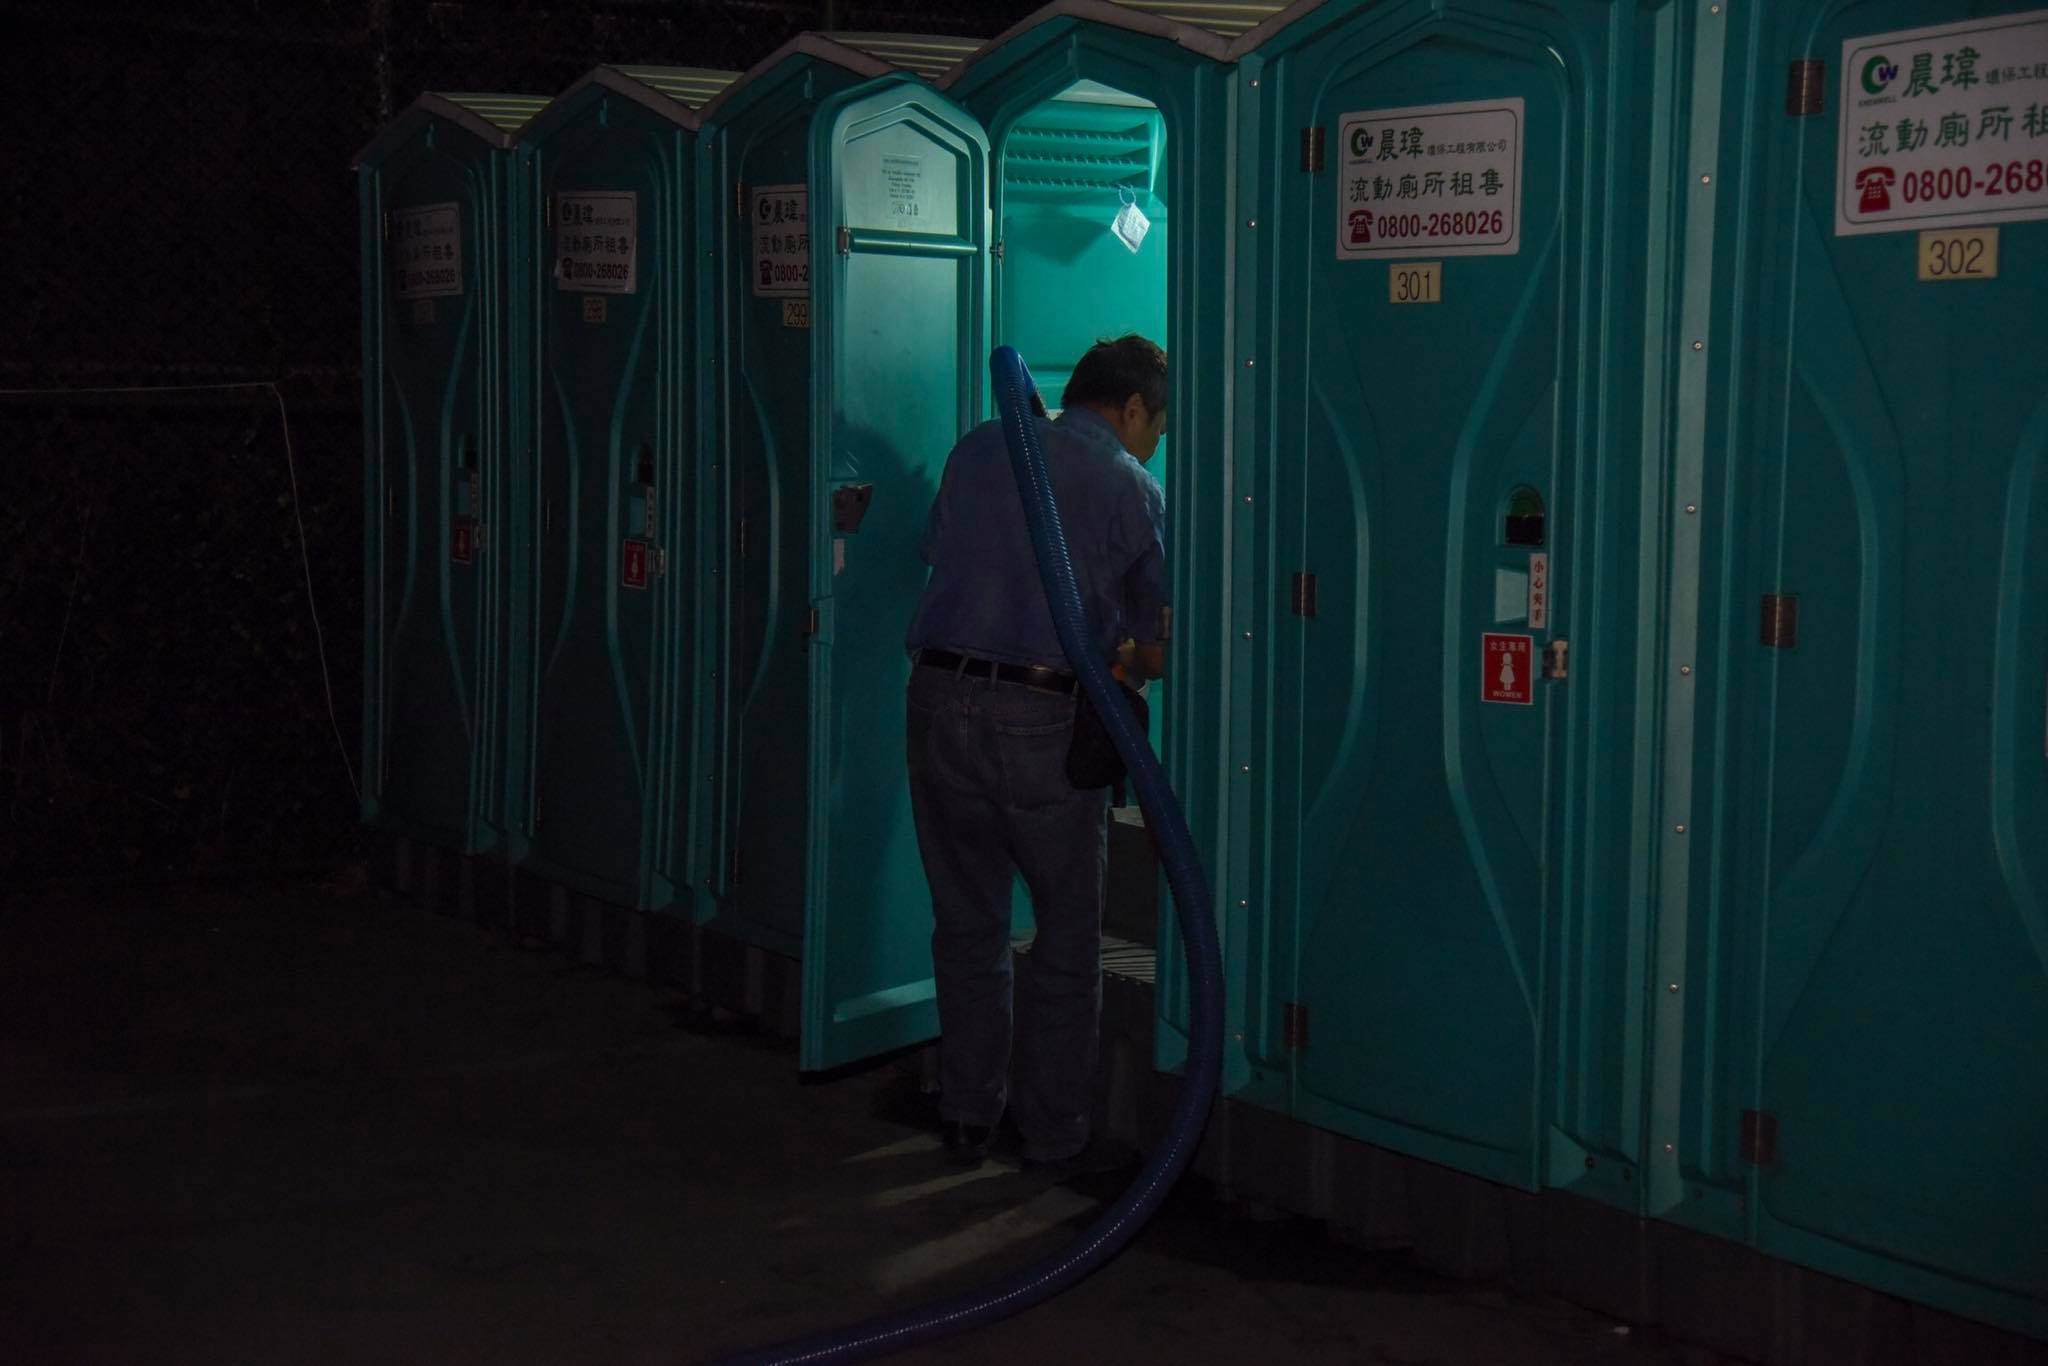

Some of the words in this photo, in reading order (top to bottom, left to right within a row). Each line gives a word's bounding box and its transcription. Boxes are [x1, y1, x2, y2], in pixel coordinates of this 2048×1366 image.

[1902, 46, 1981, 98] 晨瑋
[1376, 127, 1425, 161] 晨瑋
[1350, 168, 1503, 202] 流動廁所租售
[1903, 159, 2048, 203] 0800-268
[1377, 210, 1503, 238] 0800-268026
[1929, 238, 1984, 275] 302
[1398, 271, 1432, 301] 301
